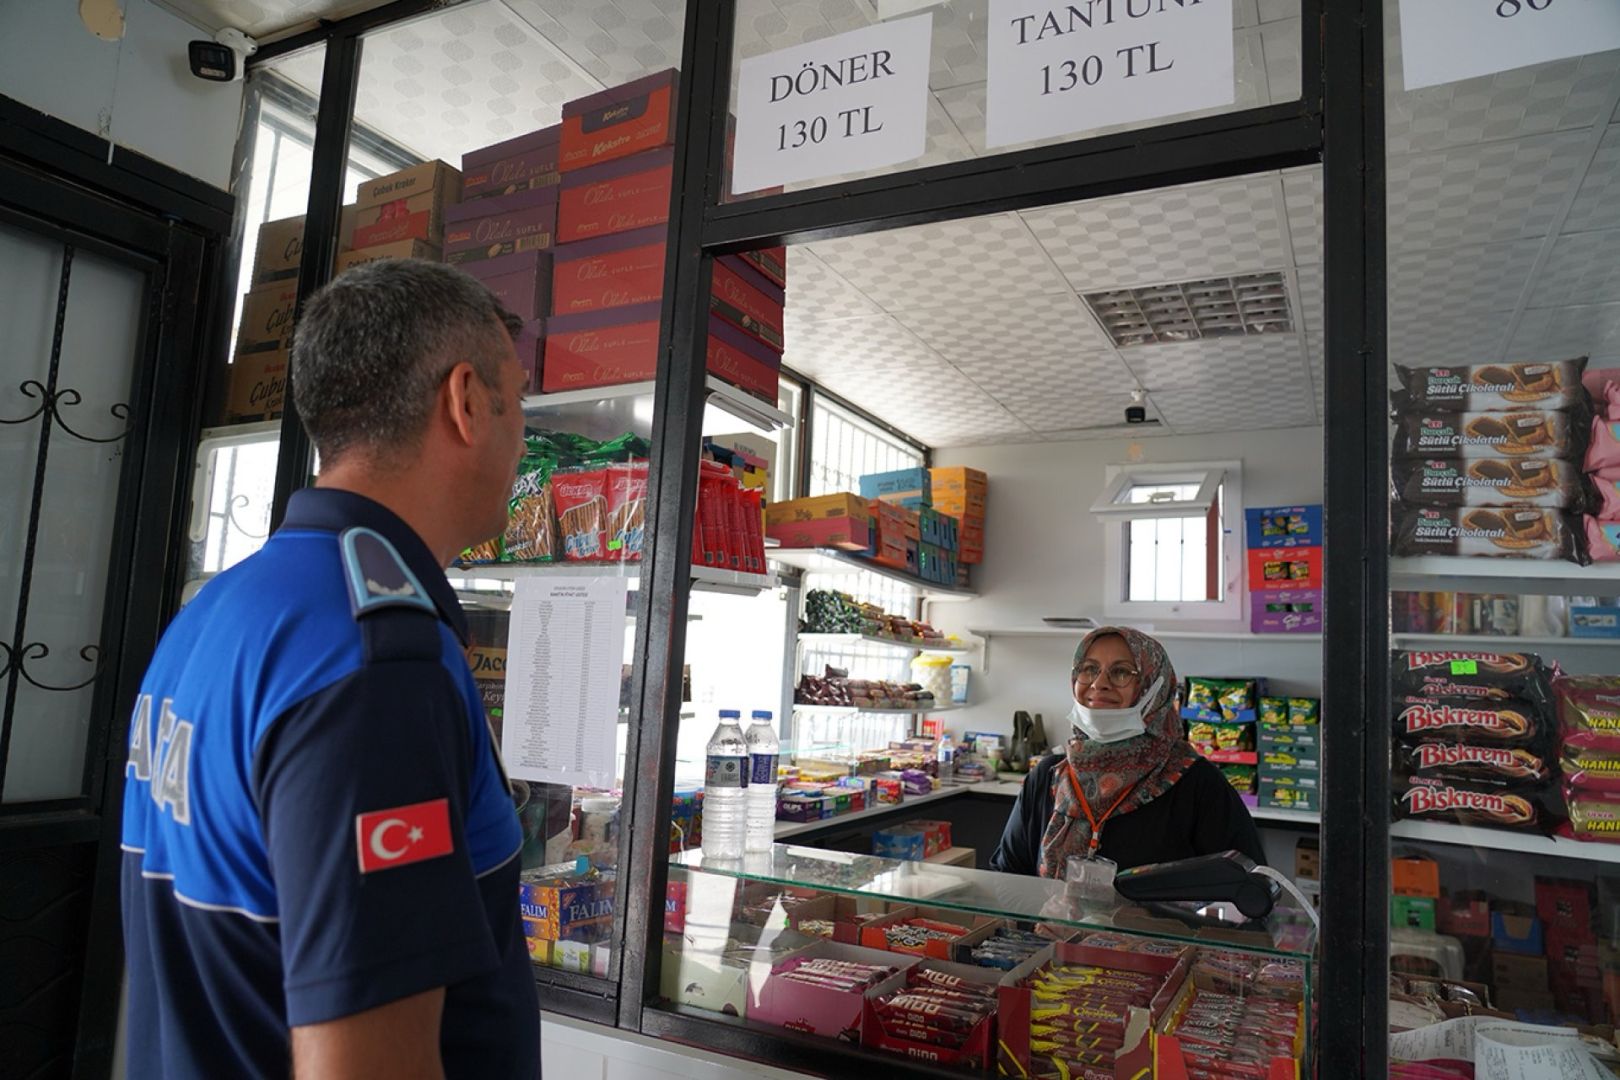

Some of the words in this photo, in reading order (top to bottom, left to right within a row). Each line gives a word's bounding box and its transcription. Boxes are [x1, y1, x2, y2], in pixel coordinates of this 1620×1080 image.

[1010, 0, 1202, 45] TANTU
[768, 50, 895, 103] DÖNER
[1041, 55, 1103, 95] 130
[1116, 41, 1175, 78] TL
[777, 115, 828, 151] 130
[838, 105, 884, 138] TL
[1426, 384, 1457, 395] Sütlü
[1458, 383, 1515, 396] Çikolatalı
[1419, 435, 1449, 446] Sütlü
[1451, 435, 1507, 447] Çikolatalı
[1422, 477, 1453, 487] Sütlü
[1455, 477, 1511, 488] Çikolatalı
[1416, 527, 1447, 537] Sütlü
[1448, 527, 1505, 539] Çikolatalı
[1419, 683, 1490, 695] Biskrem
[1398, 704, 1500, 733] Biskrem
[1412, 743, 1513, 768] Biskrem
[1401, 786, 1504, 814] Biskrem
[521, 903, 547, 918] FALIM
